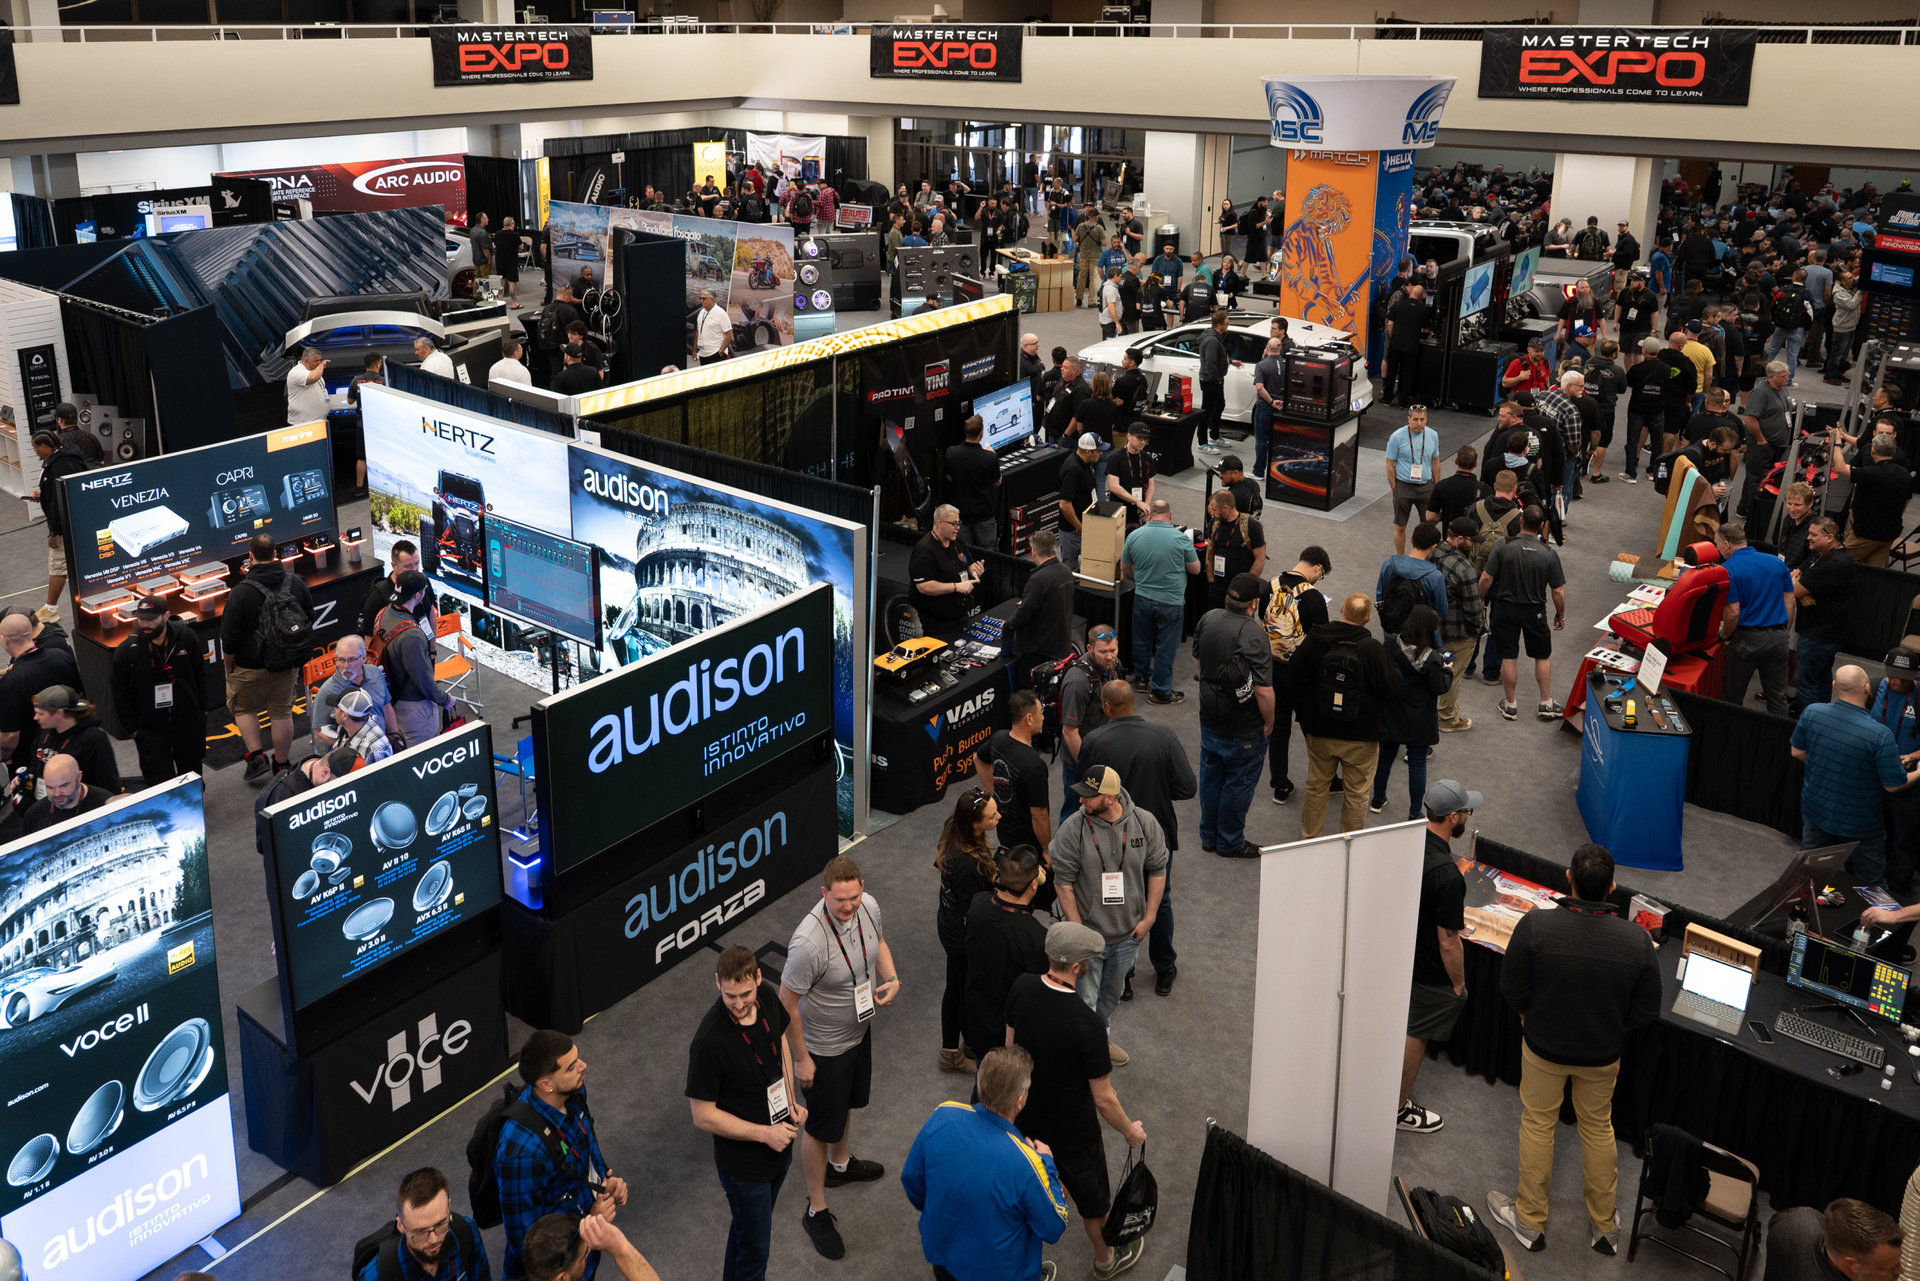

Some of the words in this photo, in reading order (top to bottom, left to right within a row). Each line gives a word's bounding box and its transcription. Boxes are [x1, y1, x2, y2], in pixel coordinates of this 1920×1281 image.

[459, 43, 569, 72] EXPO
[893, 41, 997, 69] EXPO
[1519, 50, 1706, 87] EXPO
[1550, 87, 1624, 95] PROFESSIONALS
[1270, 120, 1324, 144] MSC
[1310, 150, 1370, 164] MATCH
[1390, 150, 1413, 166] HELIX
[375, 174, 410, 189] ARC
[413, 170, 462, 185] AUDIO
[591, 173, 606, 204] AUDIO
[282, 193, 311, 201] INTERFACE
[285, 187, 316, 195] REFERENCE
[926, 371, 949, 391] TINT
[926, 388, 950, 400] SCHOOL
[282, 430, 313, 444] marine
[422, 416, 495, 455] HERTZ
[81, 472, 133, 491] HERTZ
[216, 466, 254, 486] CAPRI
[111, 487, 170, 509] VENEZIA
[583, 468, 669, 516] audison
[448, 495, 479, 512] HERTZ
[150, 554, 168, 562] Venezia
[164, 561, 181, 569] Venezia
[84, 572, 102, 580] Venezia
[107, 576, 125, 584] Venezia
[135, 568, 153, 577] Venezia
[899, 625, 916, 636] START
[588, 626, 805, 774] audison
[946, 687, 995, 724] VAIS
[947, 704, 994, 732] TECHNOLOGY
[704, 715, 768, 760] ISTINTO
[704, 711, 806, 777] INNOVATIVO
[958, 726, 992, 755] Button
[469, 738, 480, 758] II
[289, 789, 358, 830] audison
[442, 833, 451, 842] AV
[452, 825, 465, 837] K6S
[1131, 838, 1144, 849] CAT
[383, 860, 393, 870] AV
[393, 856, 399, 865] II
[400, 852, 409, 863] 10
[624, 811, 787, 939] audison
[311, 894, 322, 905] AV
[323, 886, 338, 899] K6P
[339, 883, 345, 891] II
[416, 912, 431, 924] AVX
[432, 906, 443, 916] 6.5
[443, 902, 448, 910] II
[656, 878, 765, 965] FORZA
[356, 944, 367, 955] AV
[368, 938, 380, 949] 3.0
[381, 934, 386, 942] II
[171, 956, 193, 972] AUDIO
[136, 1003, 150, 1025] II
[7, 1082, 49, 1107] audison.com
[167, 1112, 178, 1121] AV
[88, 1154, 98, 1164] AV
[98, 1148, 108, 1159] 3.0
[23, 1189, 33, 1200] AV
[43, 1153, 208, 1270] audison
[129, 1203, 180, 1239] ISTINTO
[130, 1194, 211, 1247] INNOVATIVO
